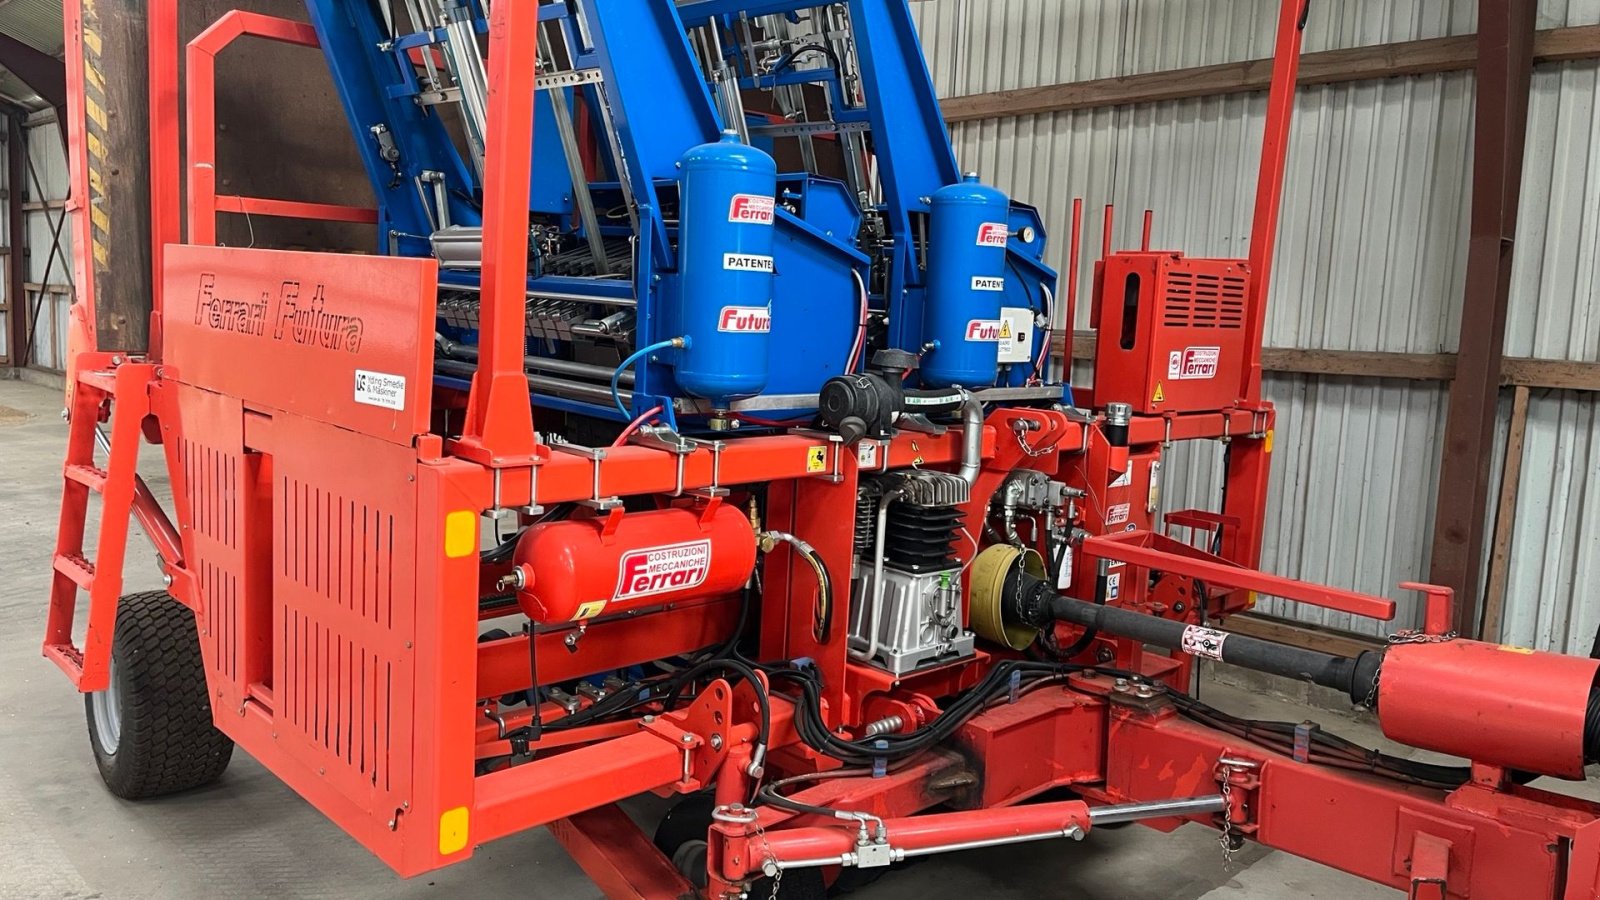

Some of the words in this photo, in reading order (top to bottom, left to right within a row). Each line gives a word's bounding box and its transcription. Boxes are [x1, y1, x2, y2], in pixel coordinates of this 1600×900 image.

[728, 257, 773, 269] PATENTE
[194, 272, 269, 337] Ferrari
[273, 280, 364, 354] Futura
[1182, 350, 1215, 375] Ferrari
[648, 546, 706, 562] COSTRUZIONI
[619, 554, 704, 595] Ferrari
[648, 557, 706, 573] MECCANICHE
